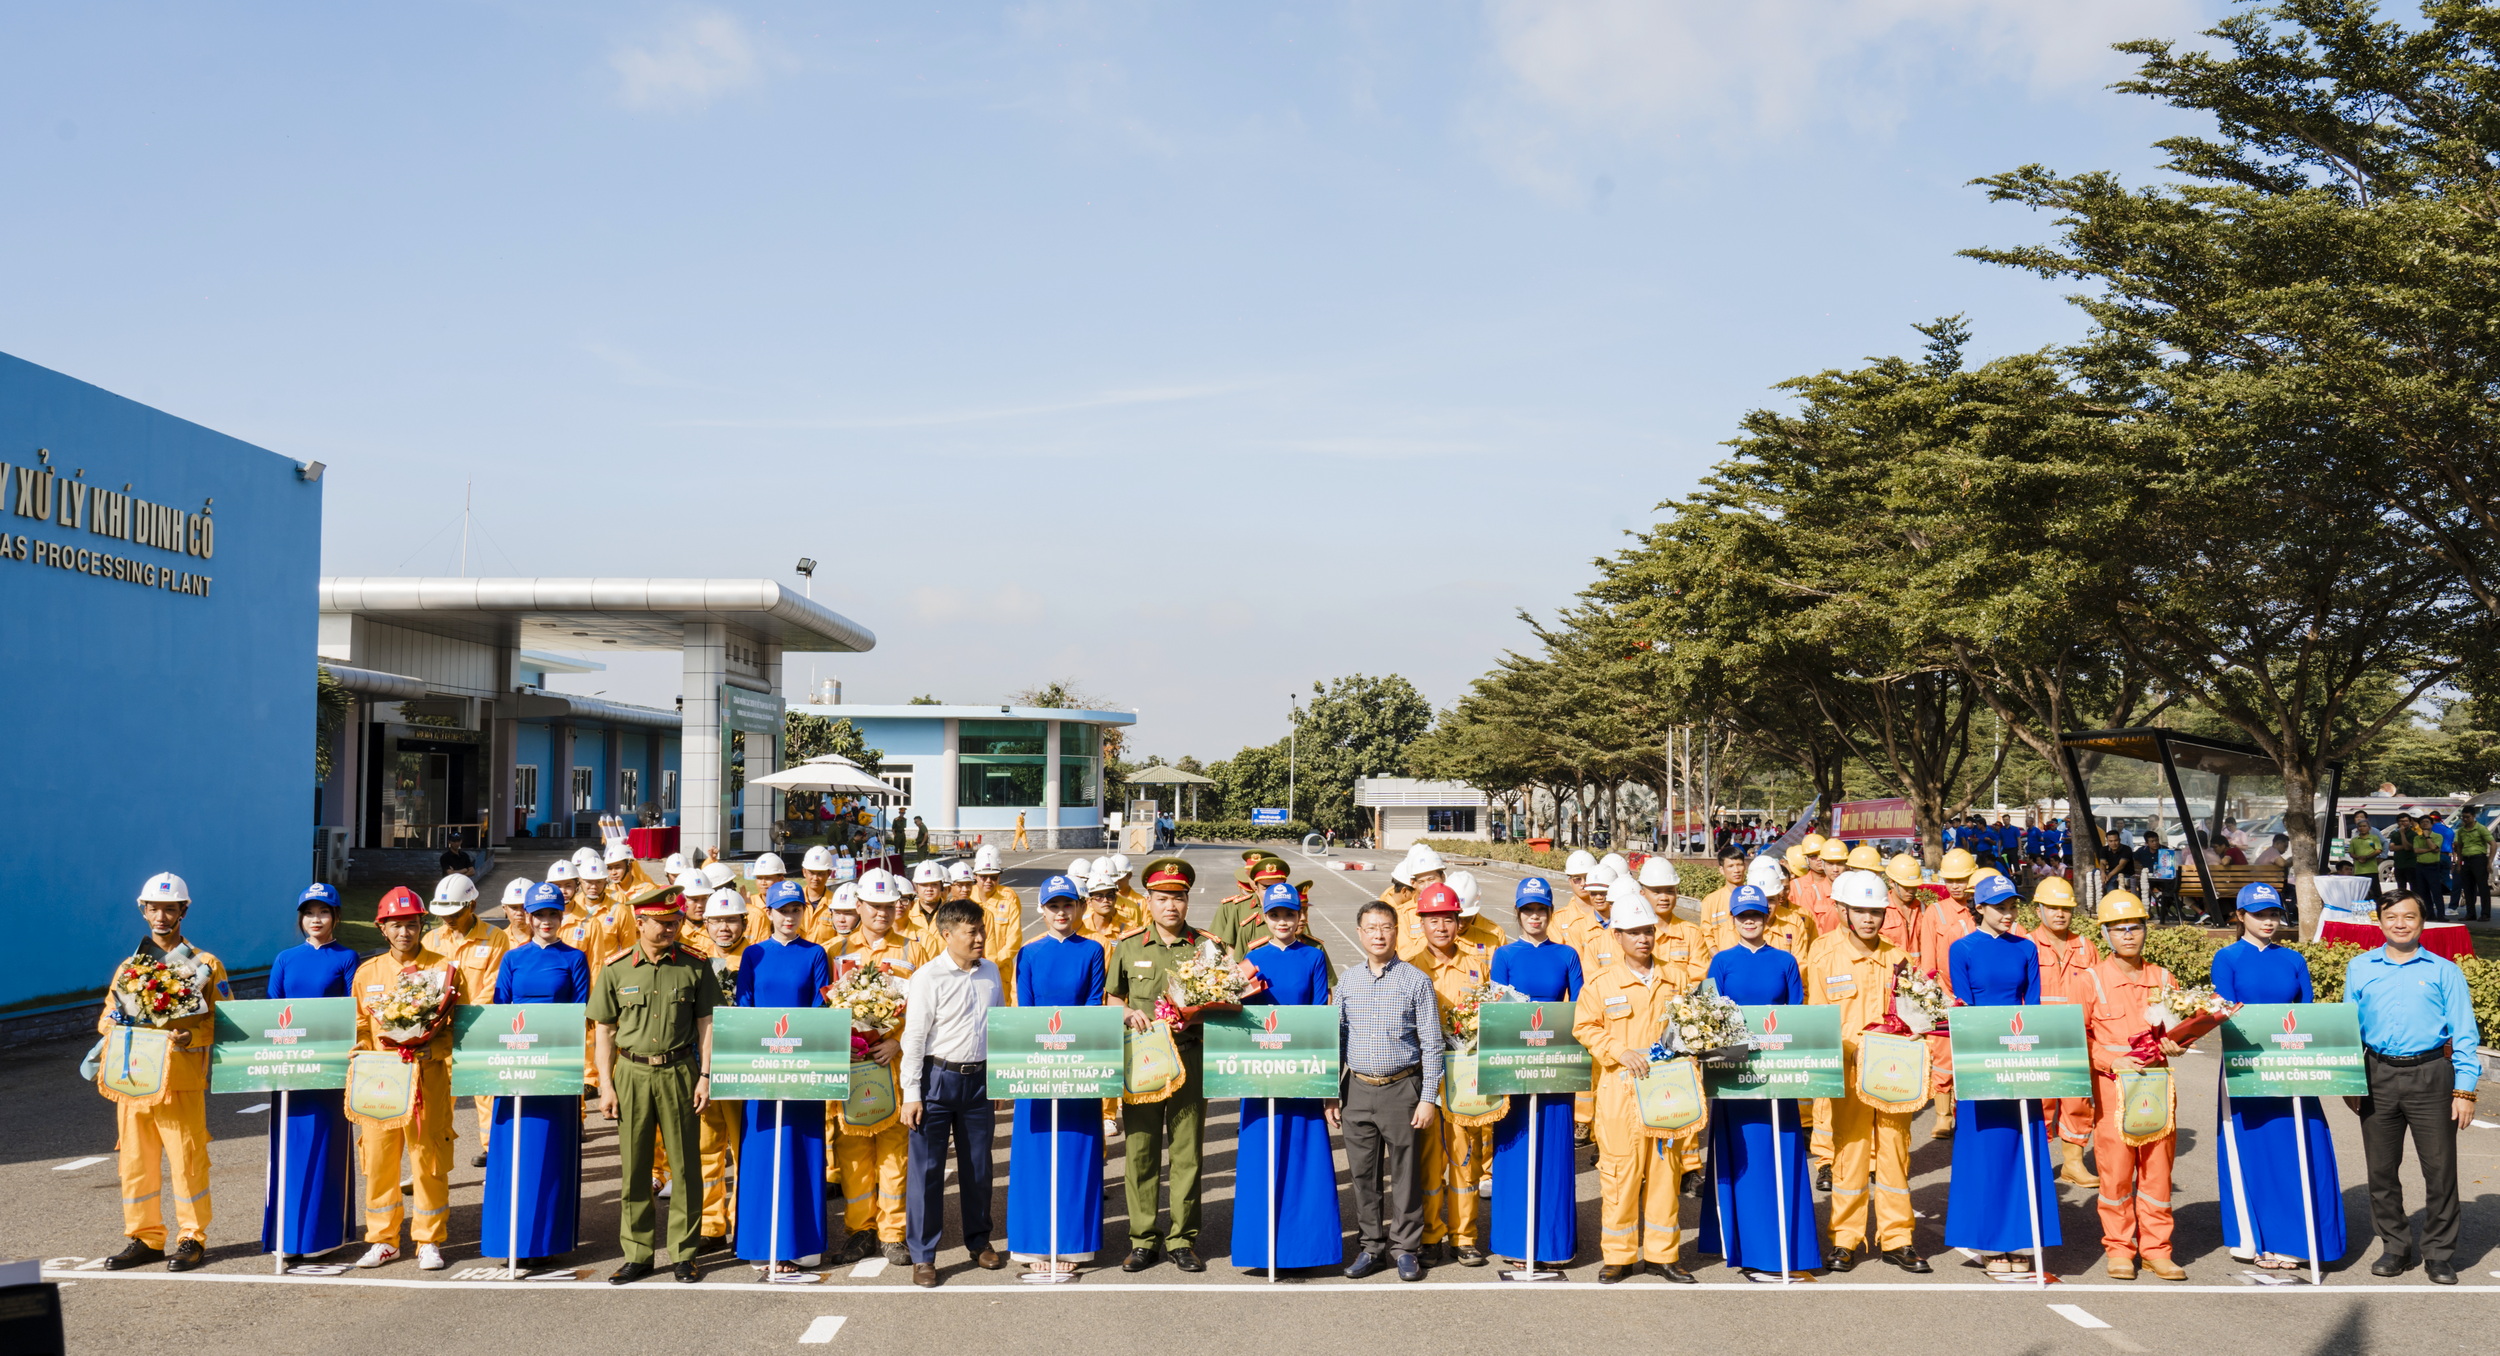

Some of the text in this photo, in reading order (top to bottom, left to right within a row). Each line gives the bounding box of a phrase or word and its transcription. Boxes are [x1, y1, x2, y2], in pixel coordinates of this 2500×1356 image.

[14, 448, 55, 520] XỬ
[57, 469, 87, 528] LÝ
[90, 483, 133, 540] KHÍ
[133, 498, 184, 552] DINH
[187, 498, 213, 559] CỐ
[33, 540, 155, 586] PROCESSING
[159, 567, 212, 597] PLANT
[254, 1049, 315, 1060] CÔNG TY CP
[488, 1053, 549, 1066] CÔNG TY KHÍ
[1027, 1052, 1084, 1064] CÔNG TY CP
[1489, 1053, 1513, 1065] CÔNG
[1515, 1055, 1526, 1064] TY
[1527, 1051, 1546, 1064] CHẾ
[1546, 1051, 1566, 1064] BIẾN
[1567, 1051, 1582, 1063] KHÍ
[1776, 1055, 1818, 1068] CHUYỂN
[1820, 1055, 1839, 1068] KHÍ
[1984, 1054, 2059, 1068] CHI NHÁNH KHÍ
[2231, 1052, 2358, 1067] CÔNG TY ĐƯỜNG ỐNG KHÍ
[247, 1062, 321, 1076] CNG VIỆT NAM
[751, 1057, 811, 1069] CÔNG TY CP
[1216, 1054, 1326, 1078] TỔ TRỌNG TÀI
[499, 1068, 536, 1080] CÀ MAU
[712, 1071, 848, 1085] KINH DOANH LPG VIỆT NAM
[996, 1065, 1115, 1079] PHÂN PHỐI KHÍ THẤP ÁP
[1515, 1066, 1556, 1079] VŨNG TÀU
[1738, 1071, 1809, 1085] ĐÔNG NAM BỘ
[1996, 1069, 2050, 1083] HẢI PHÒNG
[2261, 1069, 2331, 1081] NAM CÔN SƠN
[1009, 1080, 1099, 1095] DẦU KHÍ VIỆT NAM
